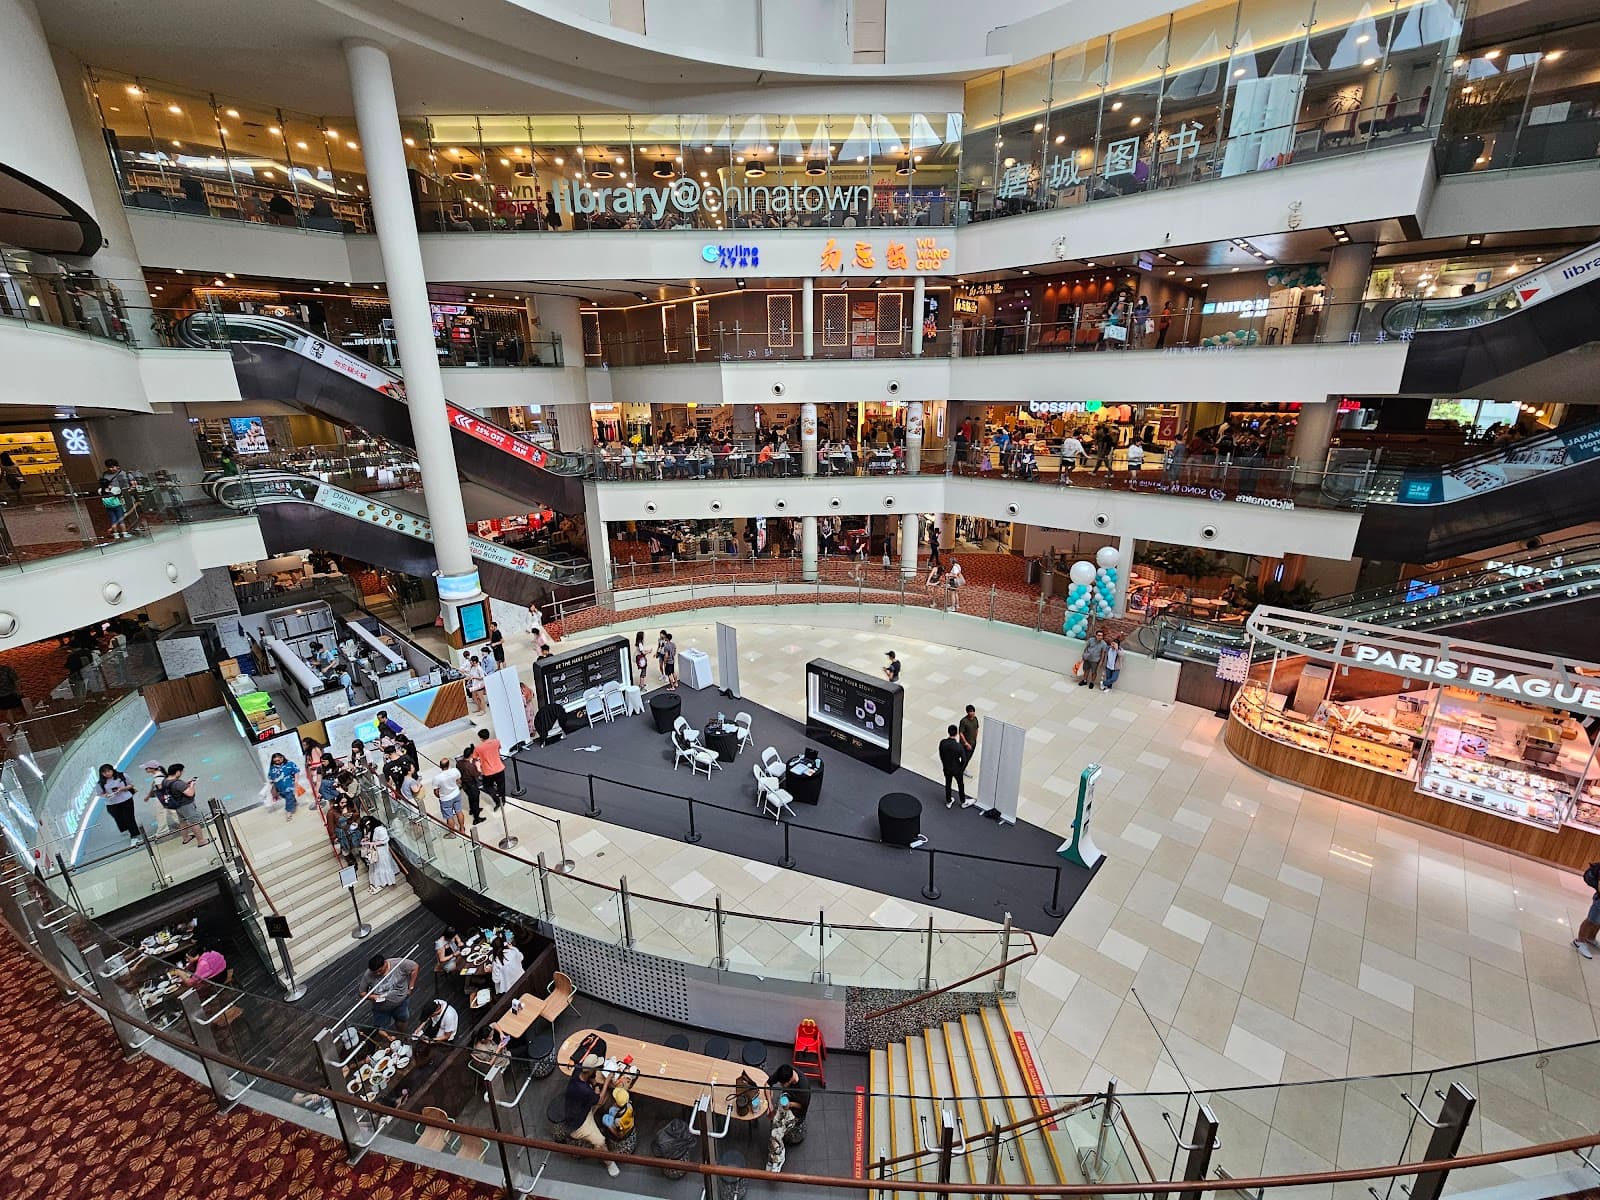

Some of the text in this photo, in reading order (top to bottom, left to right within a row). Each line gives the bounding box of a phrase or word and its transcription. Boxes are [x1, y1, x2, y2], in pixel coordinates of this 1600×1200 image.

[552, 177, 872, 221] library@chinatown
[916, 238, 936, 248] WU
[916, 248, 950, 260] WANG
[916, 259, 942, 270] GUO
[1215, 299, 1270, 314] NITORI
[1029, 400, 1086, 413] bossini
[490, 432, 505, 444] OFF
[332, 492, 358, 505] DANJI
[470, 540, 498, 553] KOREAN
[483, 552, 507, 564] BUFFET
[1355, 645, 1459, 680] PARIS
